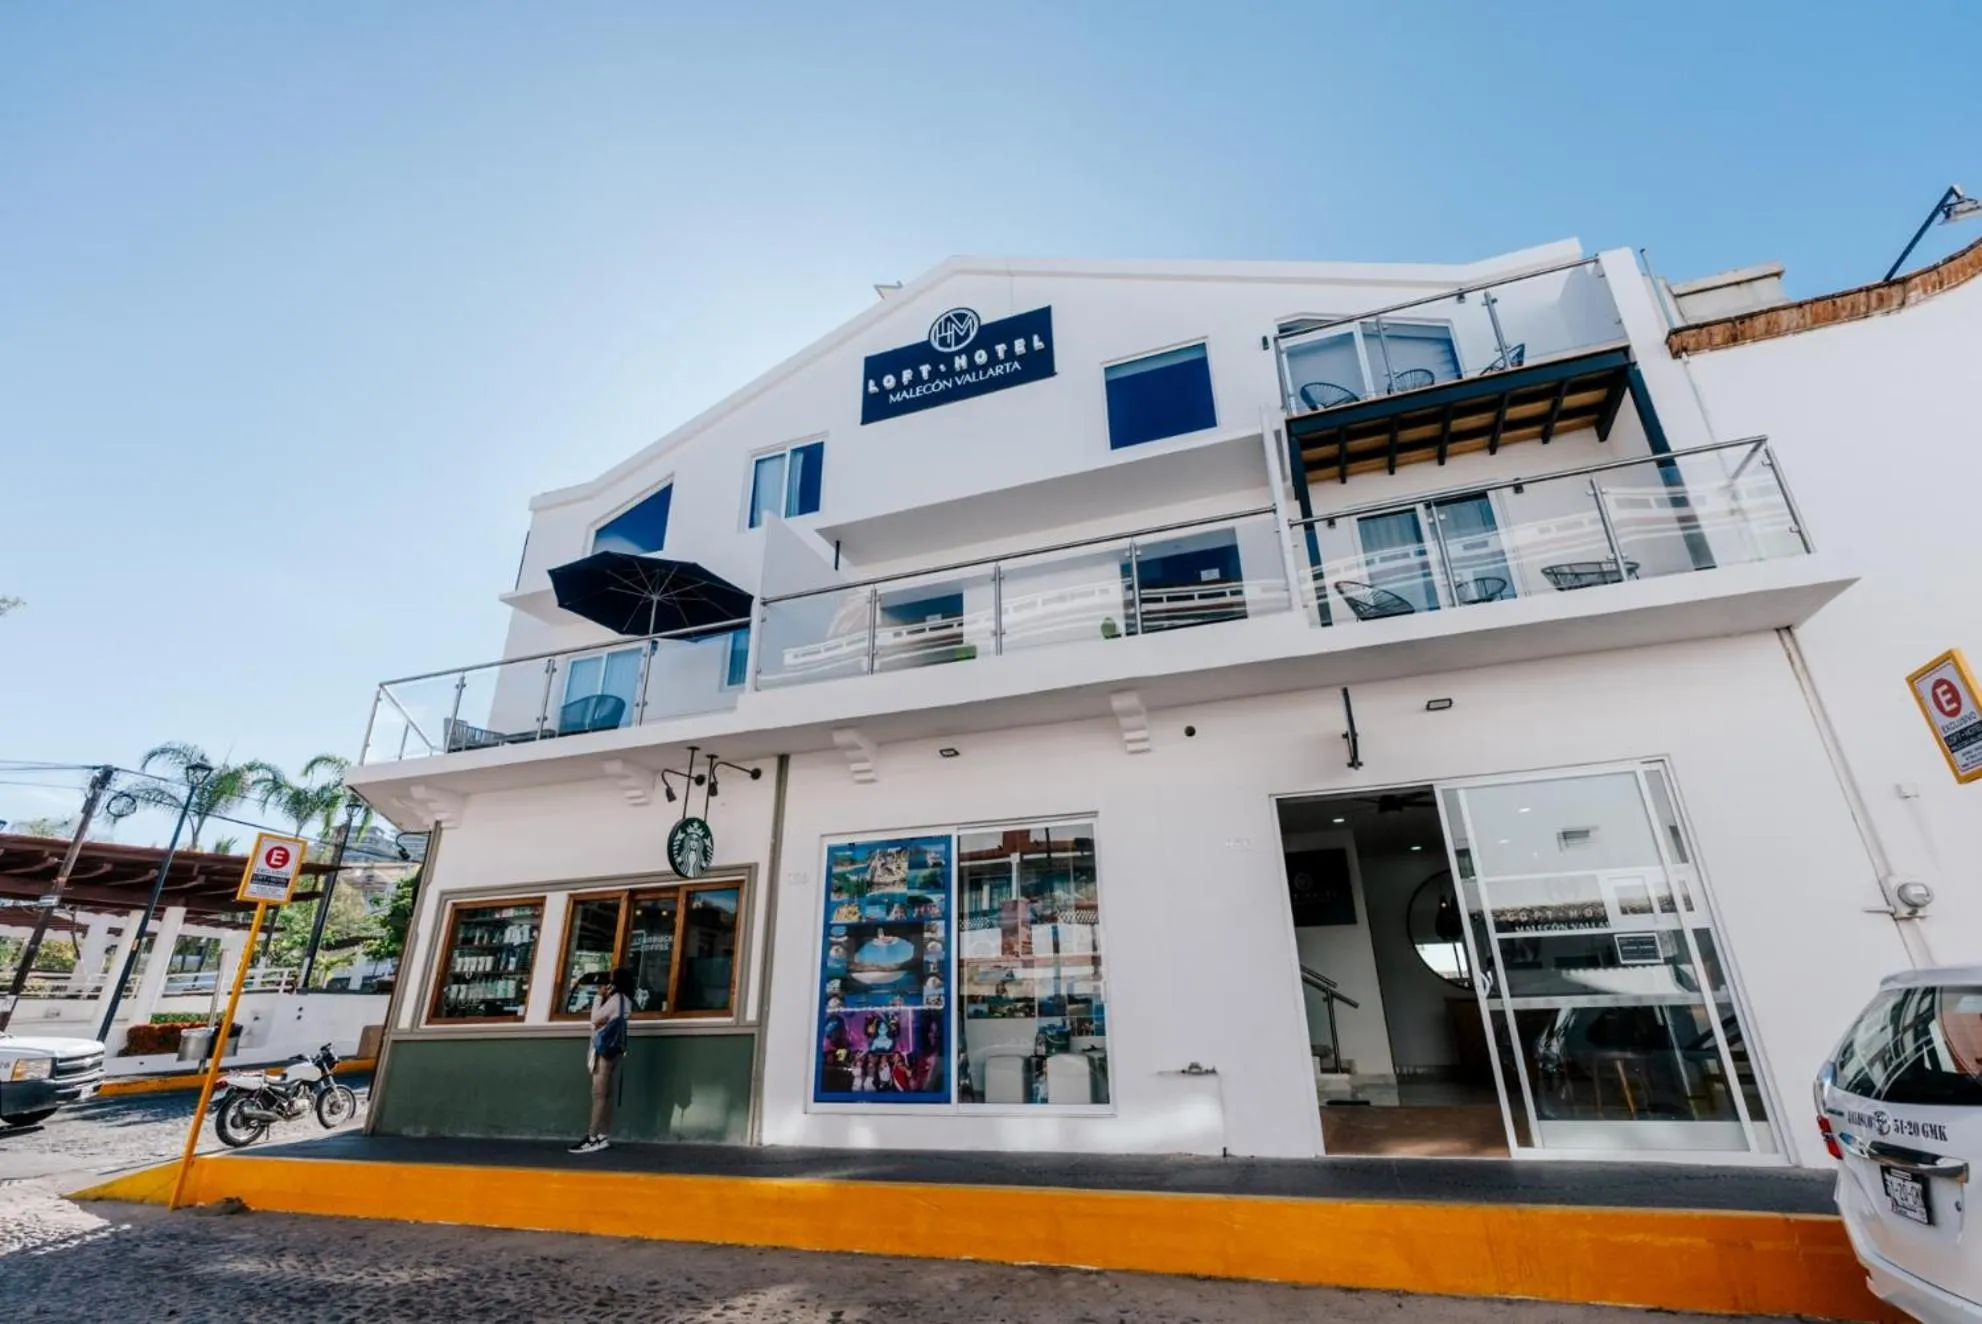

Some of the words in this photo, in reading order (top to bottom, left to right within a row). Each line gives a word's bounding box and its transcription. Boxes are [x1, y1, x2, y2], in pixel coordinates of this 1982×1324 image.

[868, 363, 932, 394] LOFT
[953, 334, 1045, 372] HOTEL
[889, 378, 952, 404] MALECÓN
[955, 361, 1021, 385] VALLARTA
[1935, 684, 1958, 712] E
[270, 849, 286, 865] E
[1894, 1119, 1919, 1137] 51-20
